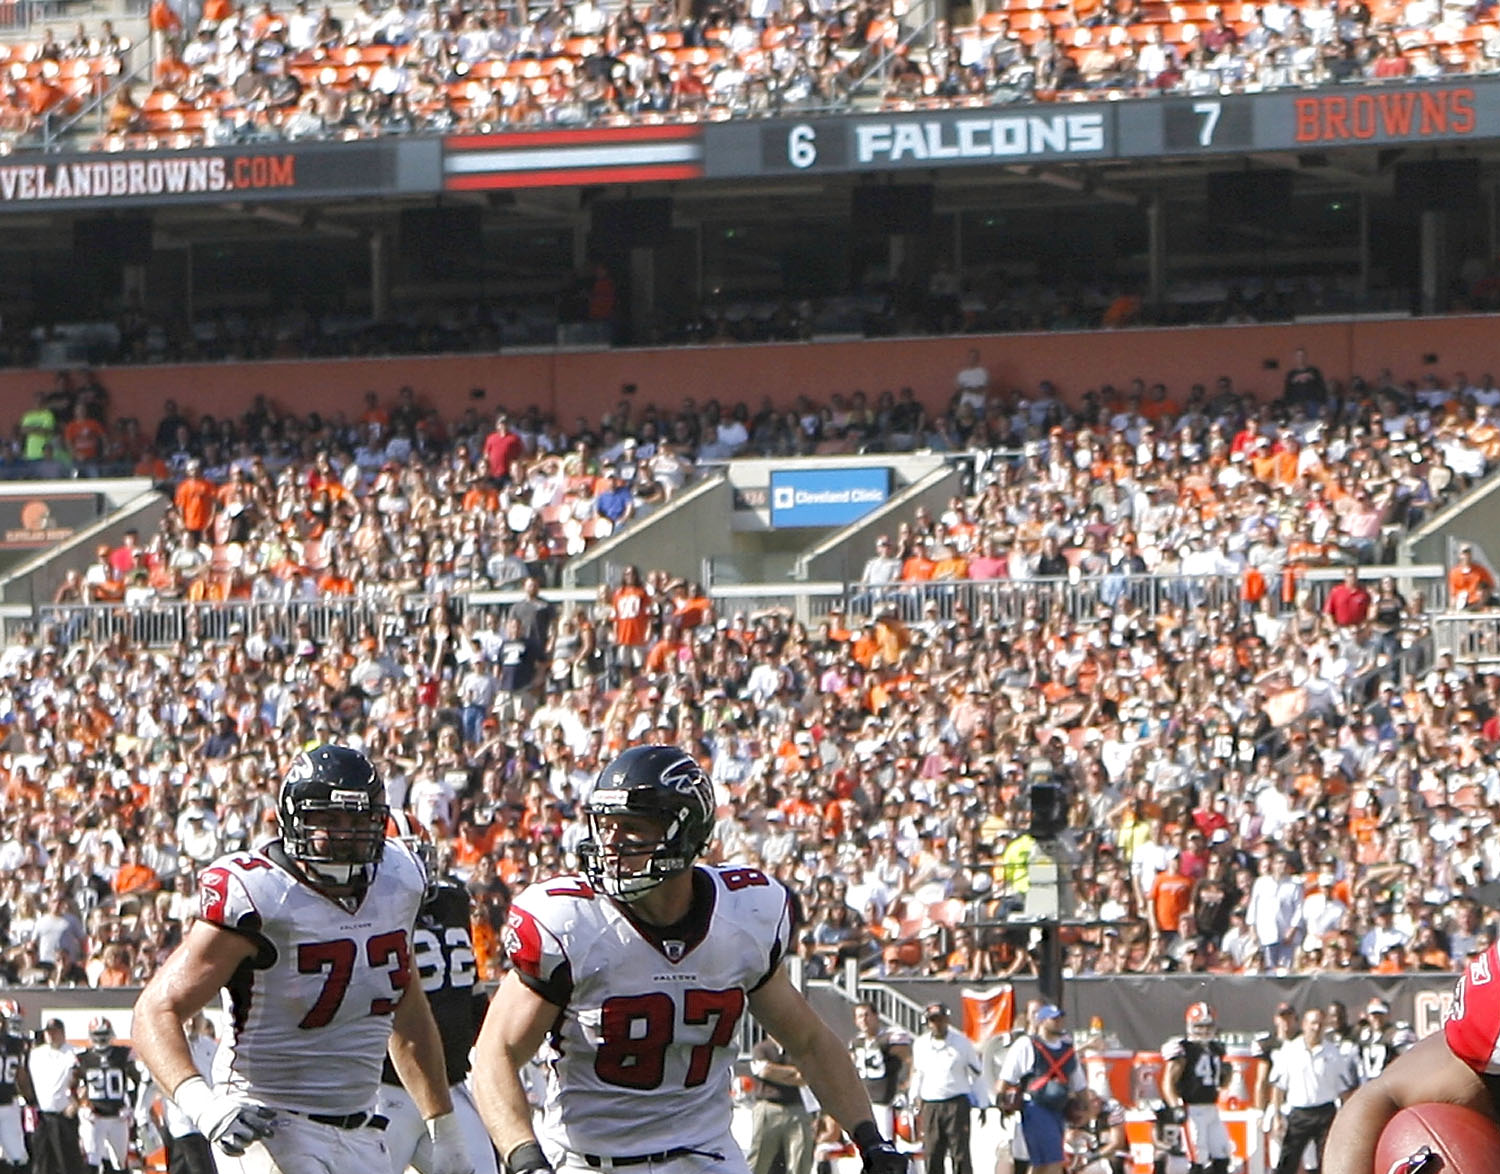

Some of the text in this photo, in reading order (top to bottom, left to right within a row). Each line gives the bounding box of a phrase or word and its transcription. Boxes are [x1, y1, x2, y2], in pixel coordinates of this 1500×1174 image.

[788, 114, 1104, 168] 6 FALCONS
[1193, 88, 1476, 147] 7 BROWNS
[795, 487, 883, 505] Cleveland Clinic
[297, 928, 414, 1029] 73
[594, 985, 745, 1091] 87
[86, 1068, 125, 1100] 20
